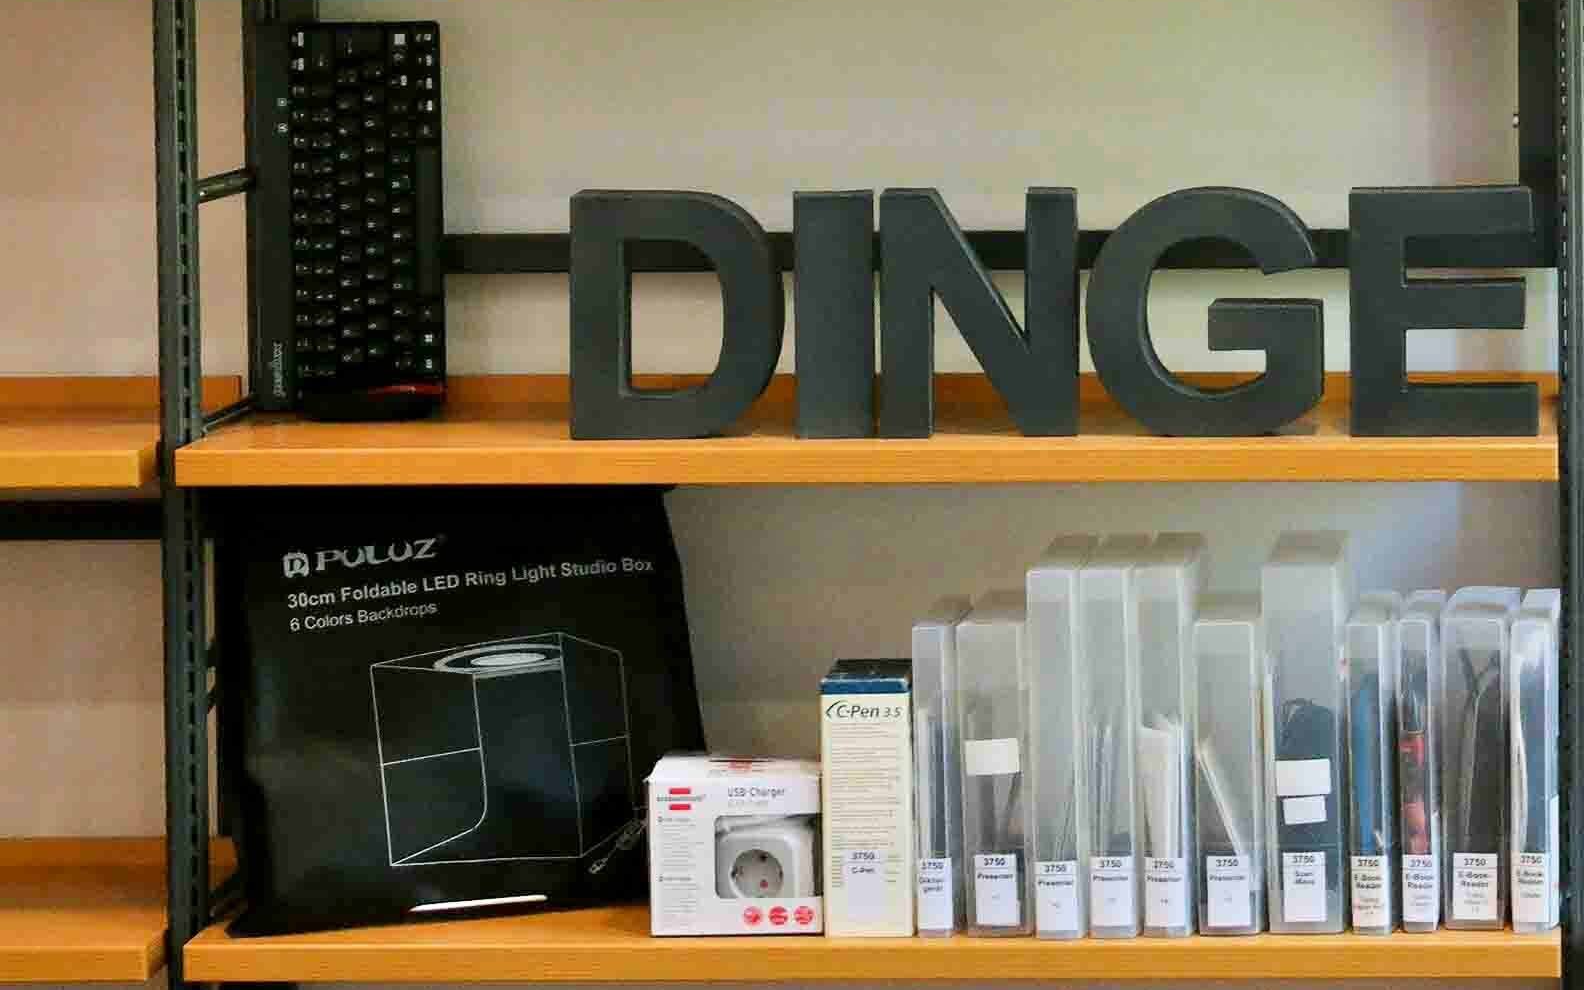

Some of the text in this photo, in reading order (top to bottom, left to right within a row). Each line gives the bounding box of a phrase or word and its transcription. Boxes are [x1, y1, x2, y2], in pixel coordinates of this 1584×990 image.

[569, 186, 1539, 439] DINGE
[314, 537, 438, 571] PULUZ
[287, 557, 654, 609] 30cm Foldable LED Ring Light Studio Box
[289, 600, 439, 632] 6 Colors Backdrops
[837, 704, 880, 718] C-Pen
